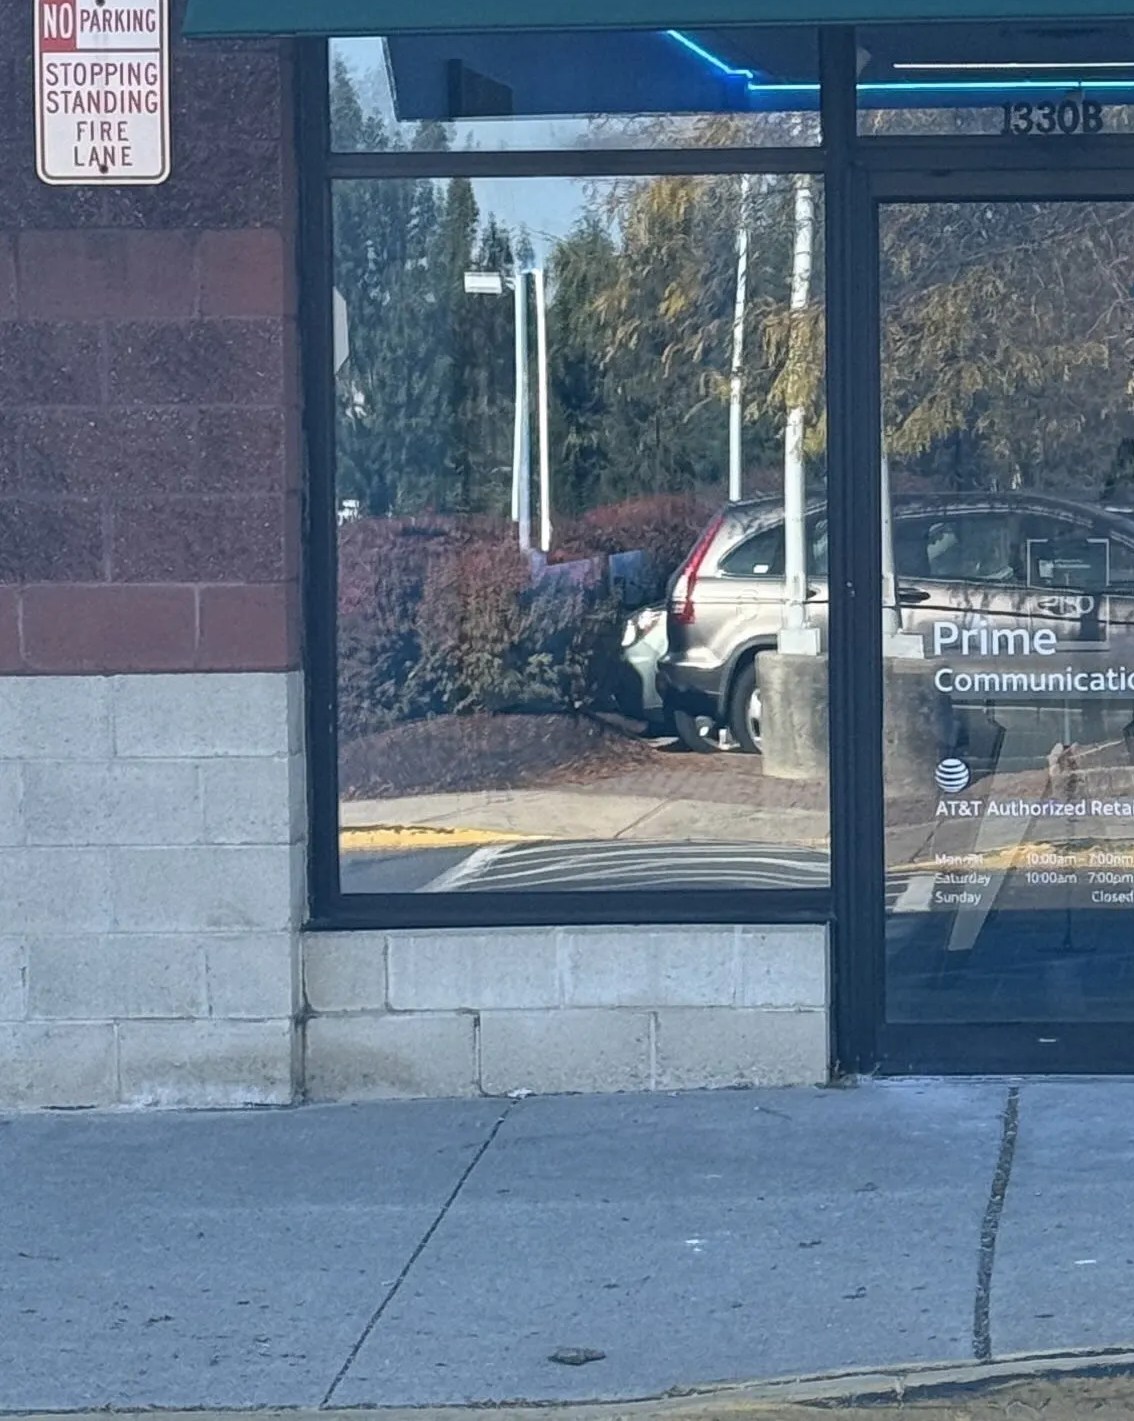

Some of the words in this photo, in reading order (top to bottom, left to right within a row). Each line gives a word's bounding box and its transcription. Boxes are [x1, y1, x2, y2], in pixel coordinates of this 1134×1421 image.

[43, 3, 73, 39] NO
[80, 9, 156, 33] PARKING
[46, 63, 158, 86] STOPPING
[46, 90, 158, 114] STANDING
[1003, 100, 1104, 134] 1330B
[77, 121, 129, 142] FIRE
[74, 146, 133, 167] LANE
[933, 620, 1057, 656] Prime
[936, 800, 982, 816] AT&T
[987, 799, 1085, 816] Authorized
[935, 872, 991, 886] Saturday
[1026, 872, 1077, 884] 10:00am
[1088, 872, 1134, 886] 7:00pm
[935, 891, 982, 905] Sunday
[1091, 890, 1134, 904] Closed
